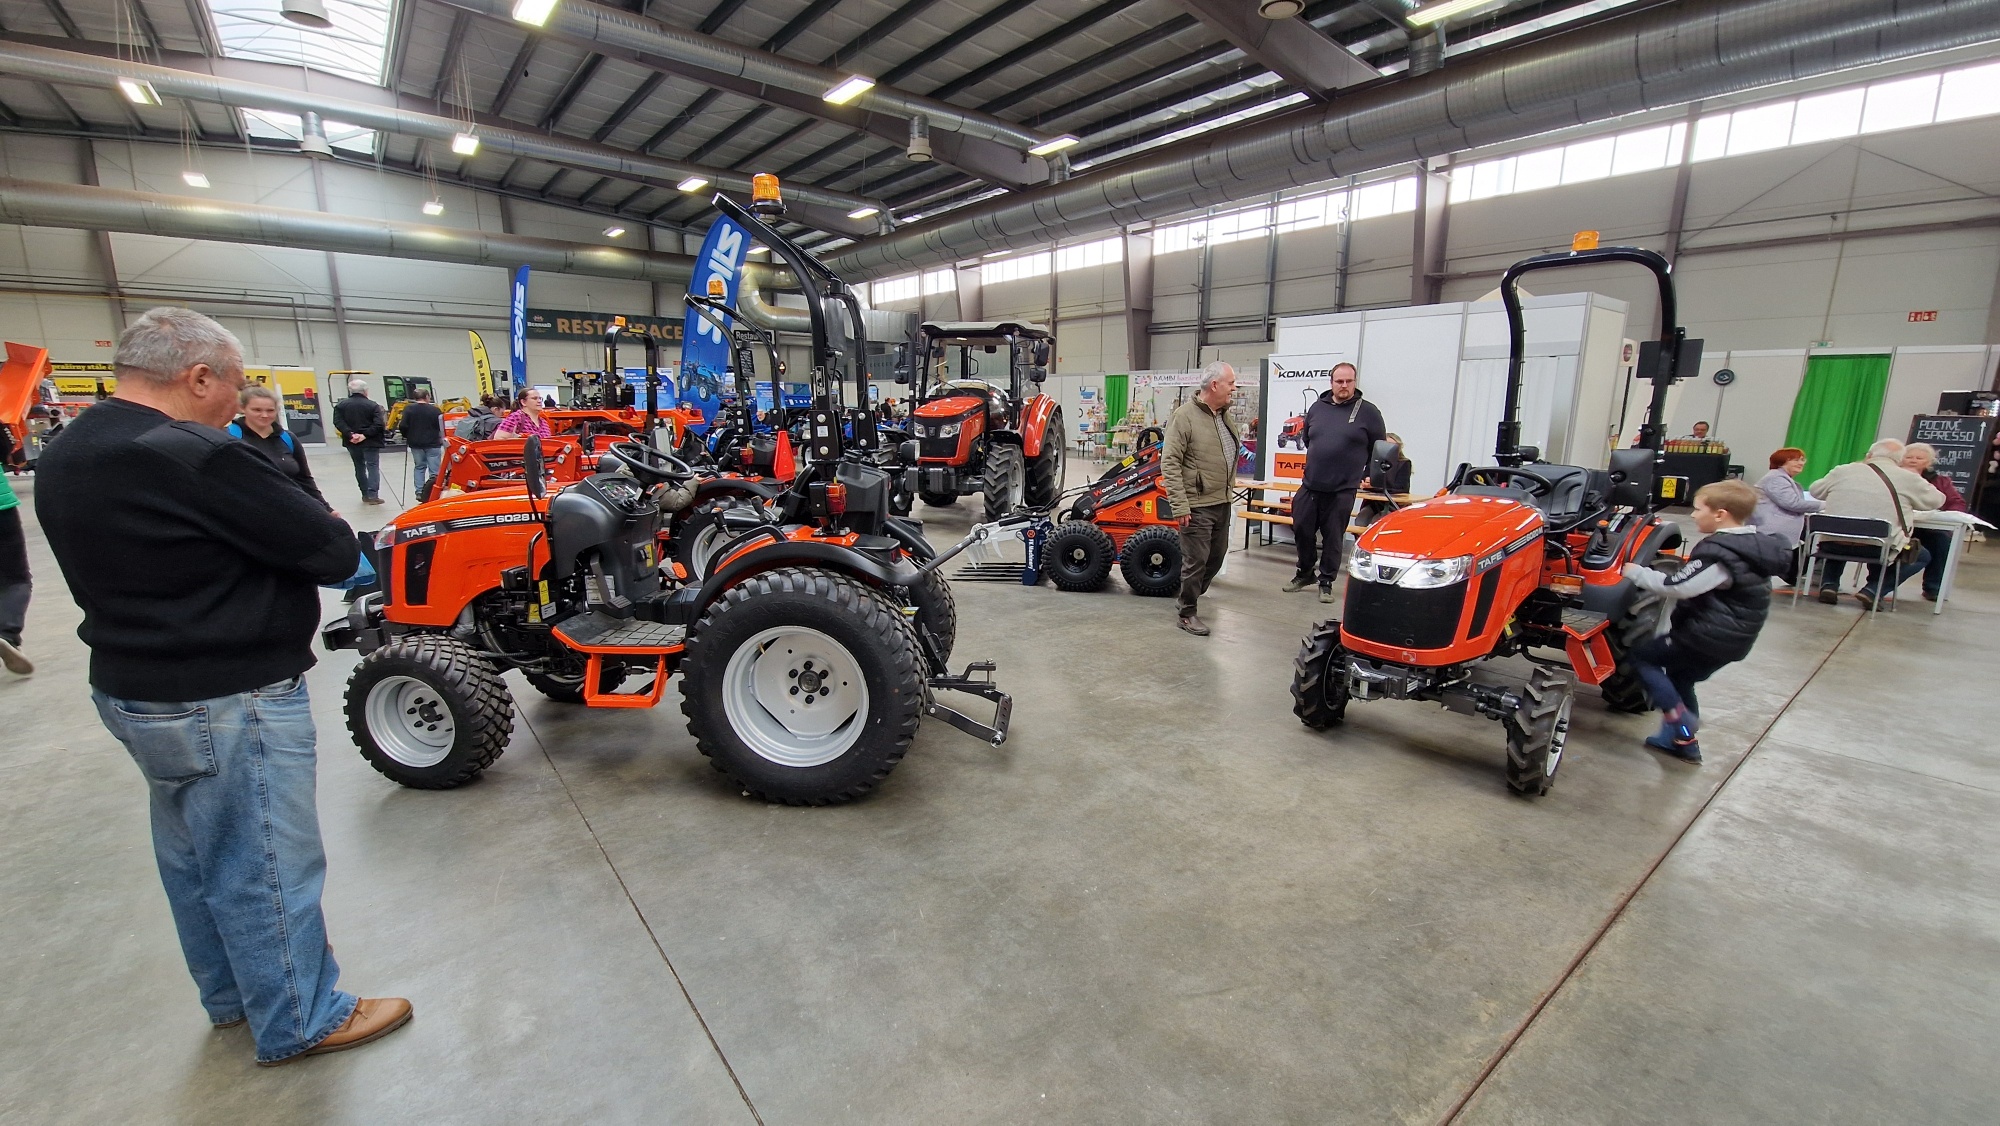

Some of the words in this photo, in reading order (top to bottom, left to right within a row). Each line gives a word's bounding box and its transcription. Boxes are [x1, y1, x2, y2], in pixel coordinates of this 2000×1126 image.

[514, 281, 525, 363] SOLIS
[556, 318, 683, 340] RESTRACE
[1919, 419, 1962, 432] POCTIVÉ
[1917, 431, 1974, 442] ESPRESSO
[1277, 462, 1306, 470] TAFE
[496, 513, 530, 523] 6028
[403, 525, 437, 539] TAFE
[1478, 551, 1503, 570] TAFE
